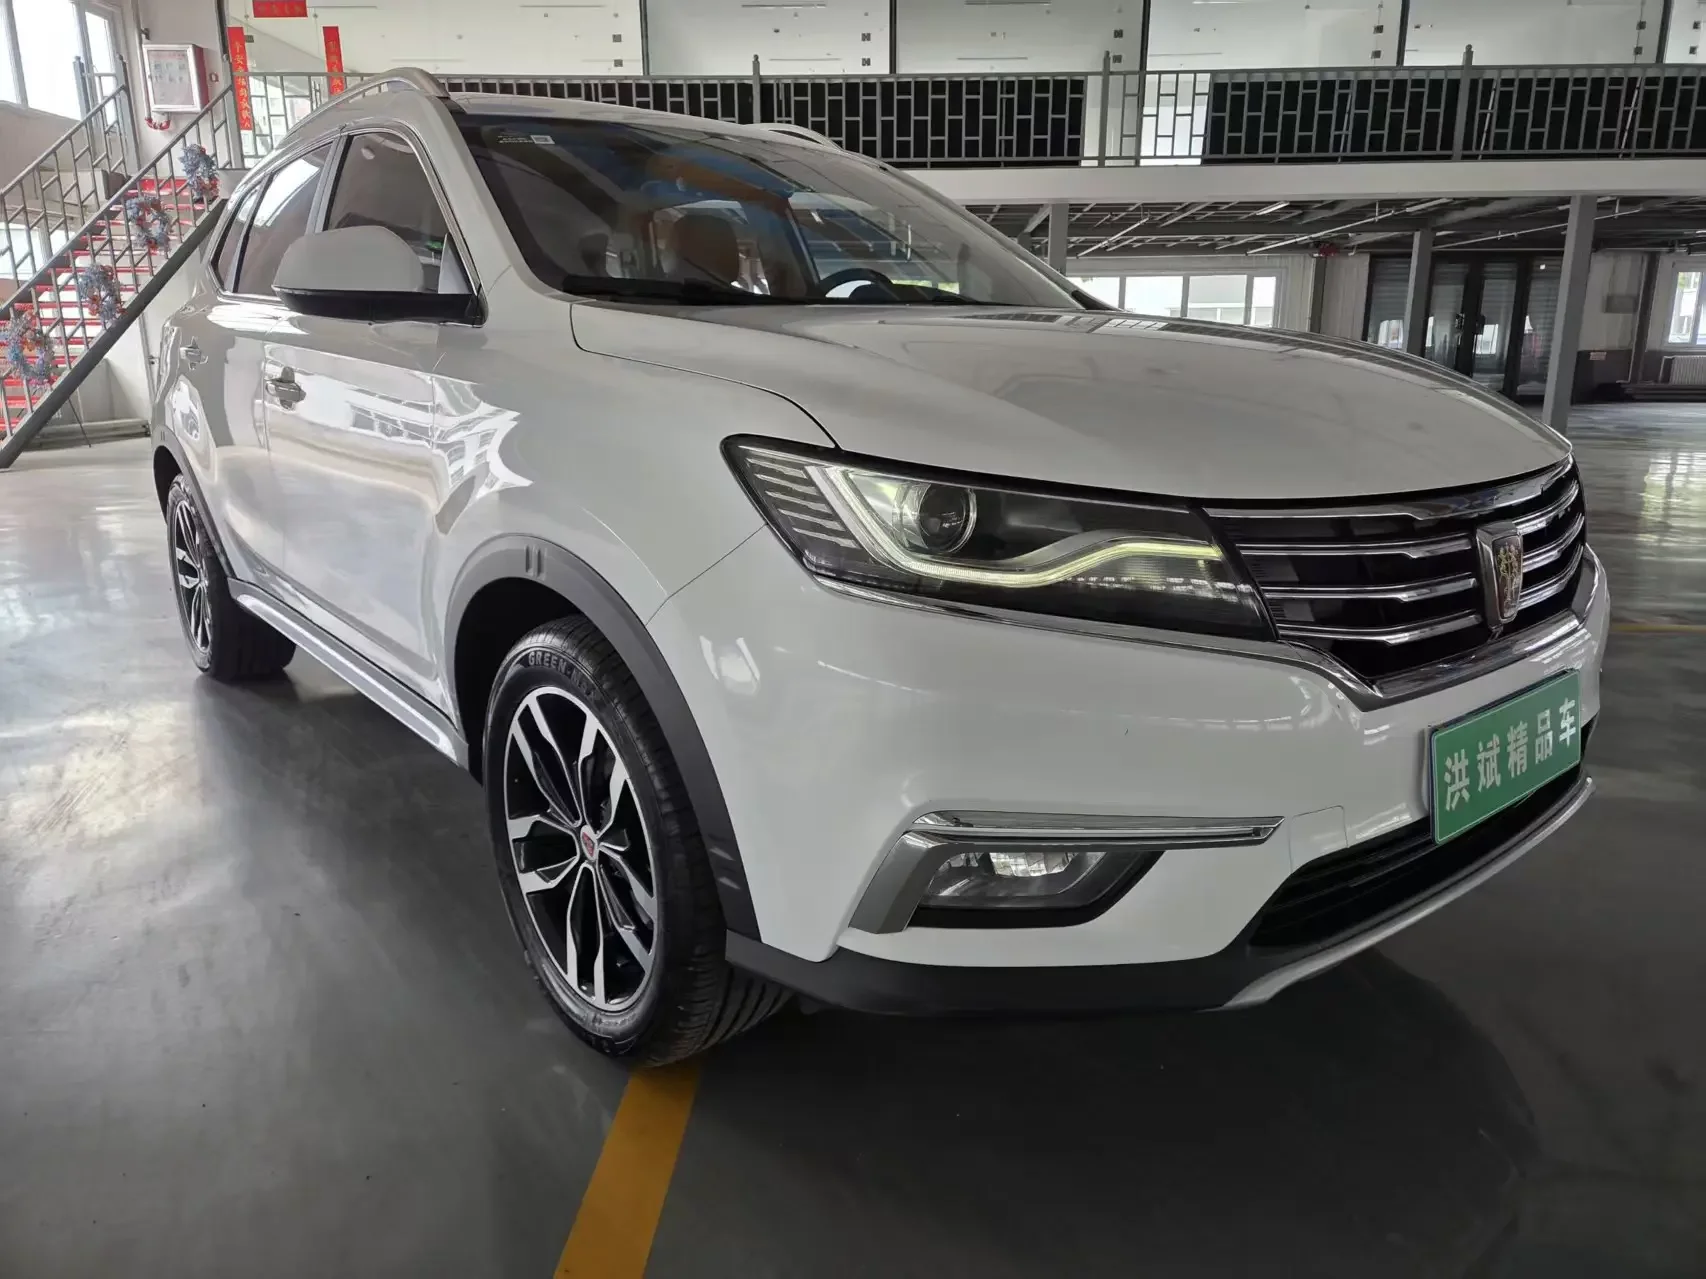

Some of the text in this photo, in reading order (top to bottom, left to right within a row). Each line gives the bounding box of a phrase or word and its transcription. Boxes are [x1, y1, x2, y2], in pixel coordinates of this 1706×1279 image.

[1444, 697, 1576, 811] 洪斌精品车
